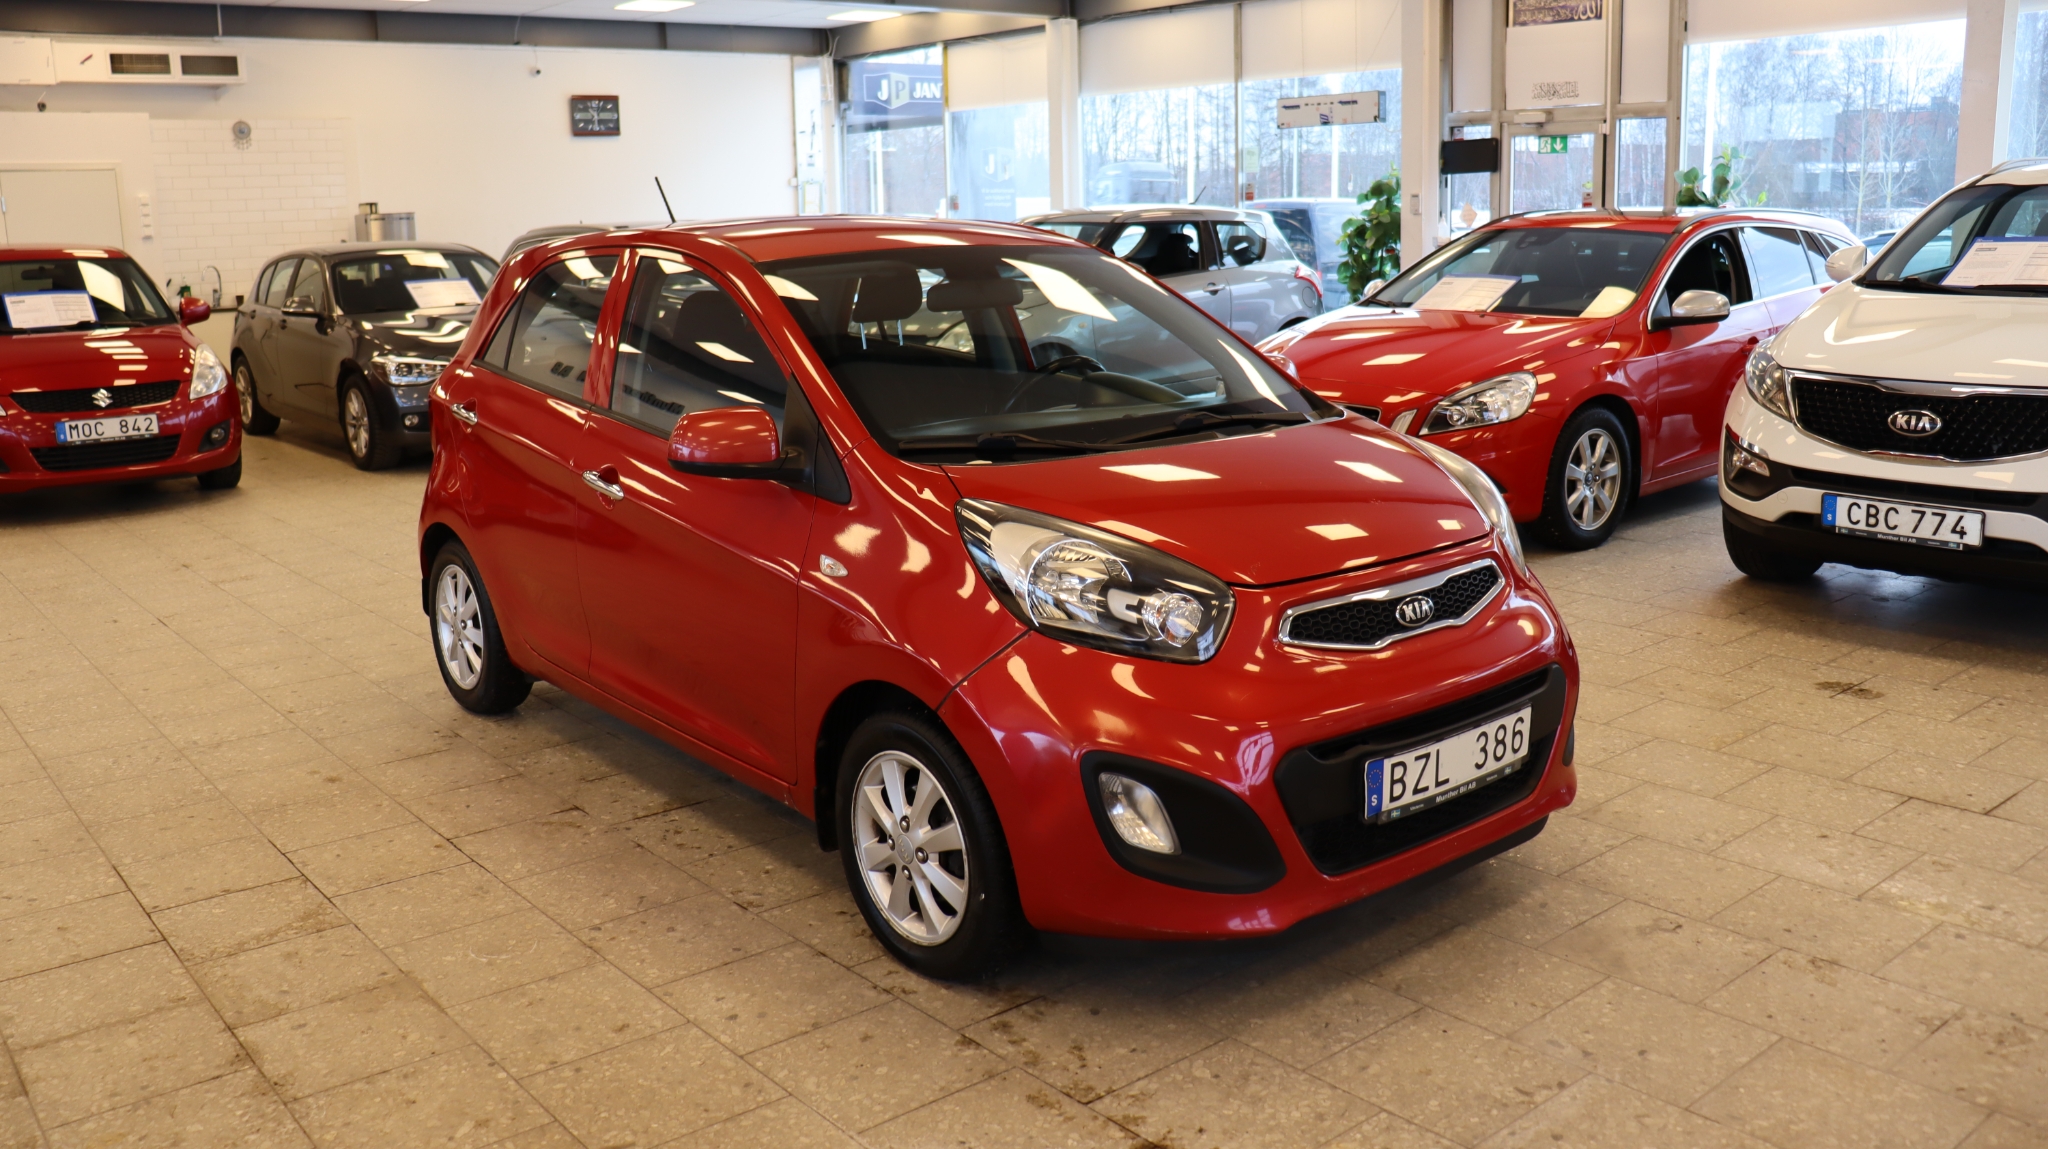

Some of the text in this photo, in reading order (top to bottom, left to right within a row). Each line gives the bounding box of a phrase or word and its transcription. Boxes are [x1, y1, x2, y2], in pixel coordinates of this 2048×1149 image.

[912, 82, 944, 99] JAN
[68, 417, 154, 439] MOC 842
[1895, 414, 1931, 431] KIA
[1826, 513, 1832, 521] S
[1847, 502, 1967, 540] CBC 774
[1402, 600, 1431, 622] KIA
[1389, 716, 1525, 804] BZL 386
[1371, 794, 1378, 807] S
[1435, 781, 1477, 804] Munther Bil AB
